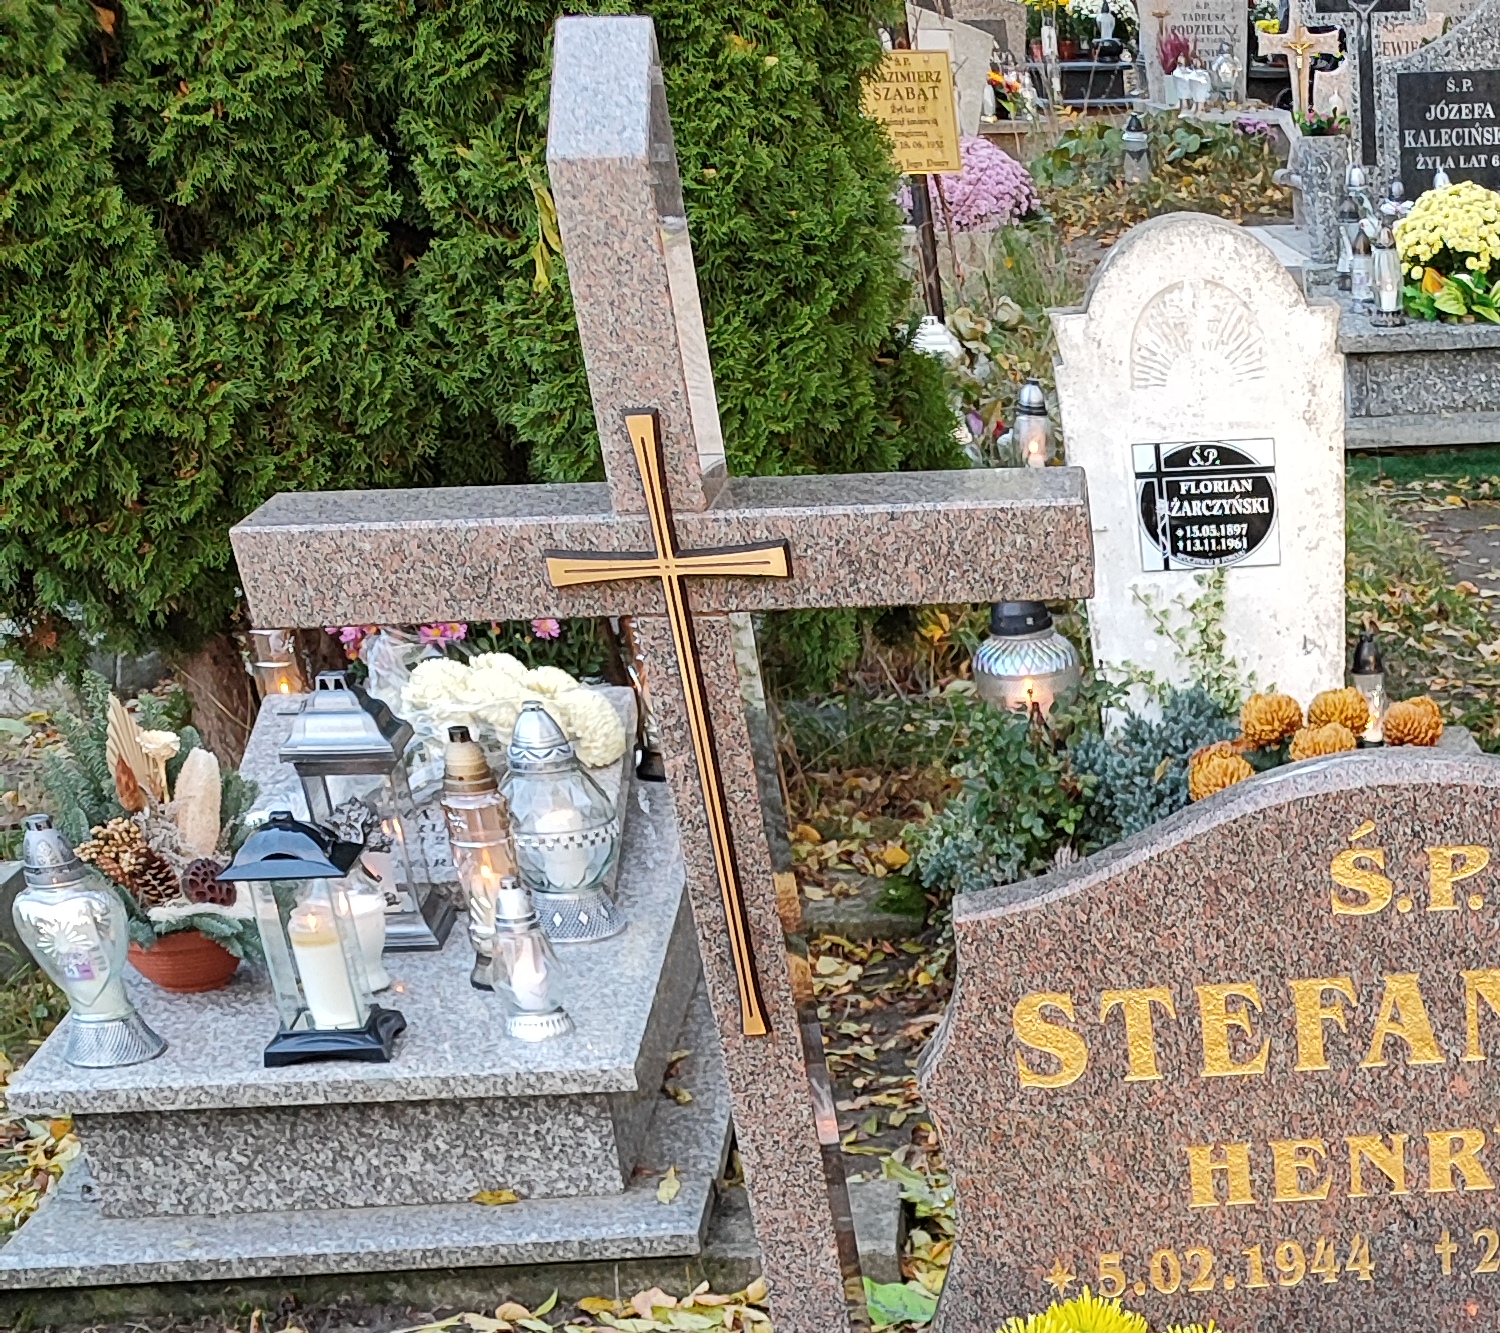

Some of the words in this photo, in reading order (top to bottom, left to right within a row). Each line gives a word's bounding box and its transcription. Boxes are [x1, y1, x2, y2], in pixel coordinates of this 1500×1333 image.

[878, 70, 942, 83] AZIMIERZ
[1425, 100, 1495, 121] JÓZEFA
[1459, 155, 1488, 168] LAT
[1179, 478, 1253, 495] FLORIAN
[1170, 494, 1270, 517] ŻARCZYŃSKI
[1097, 1232, 1376, 1298] 5.02.1944
